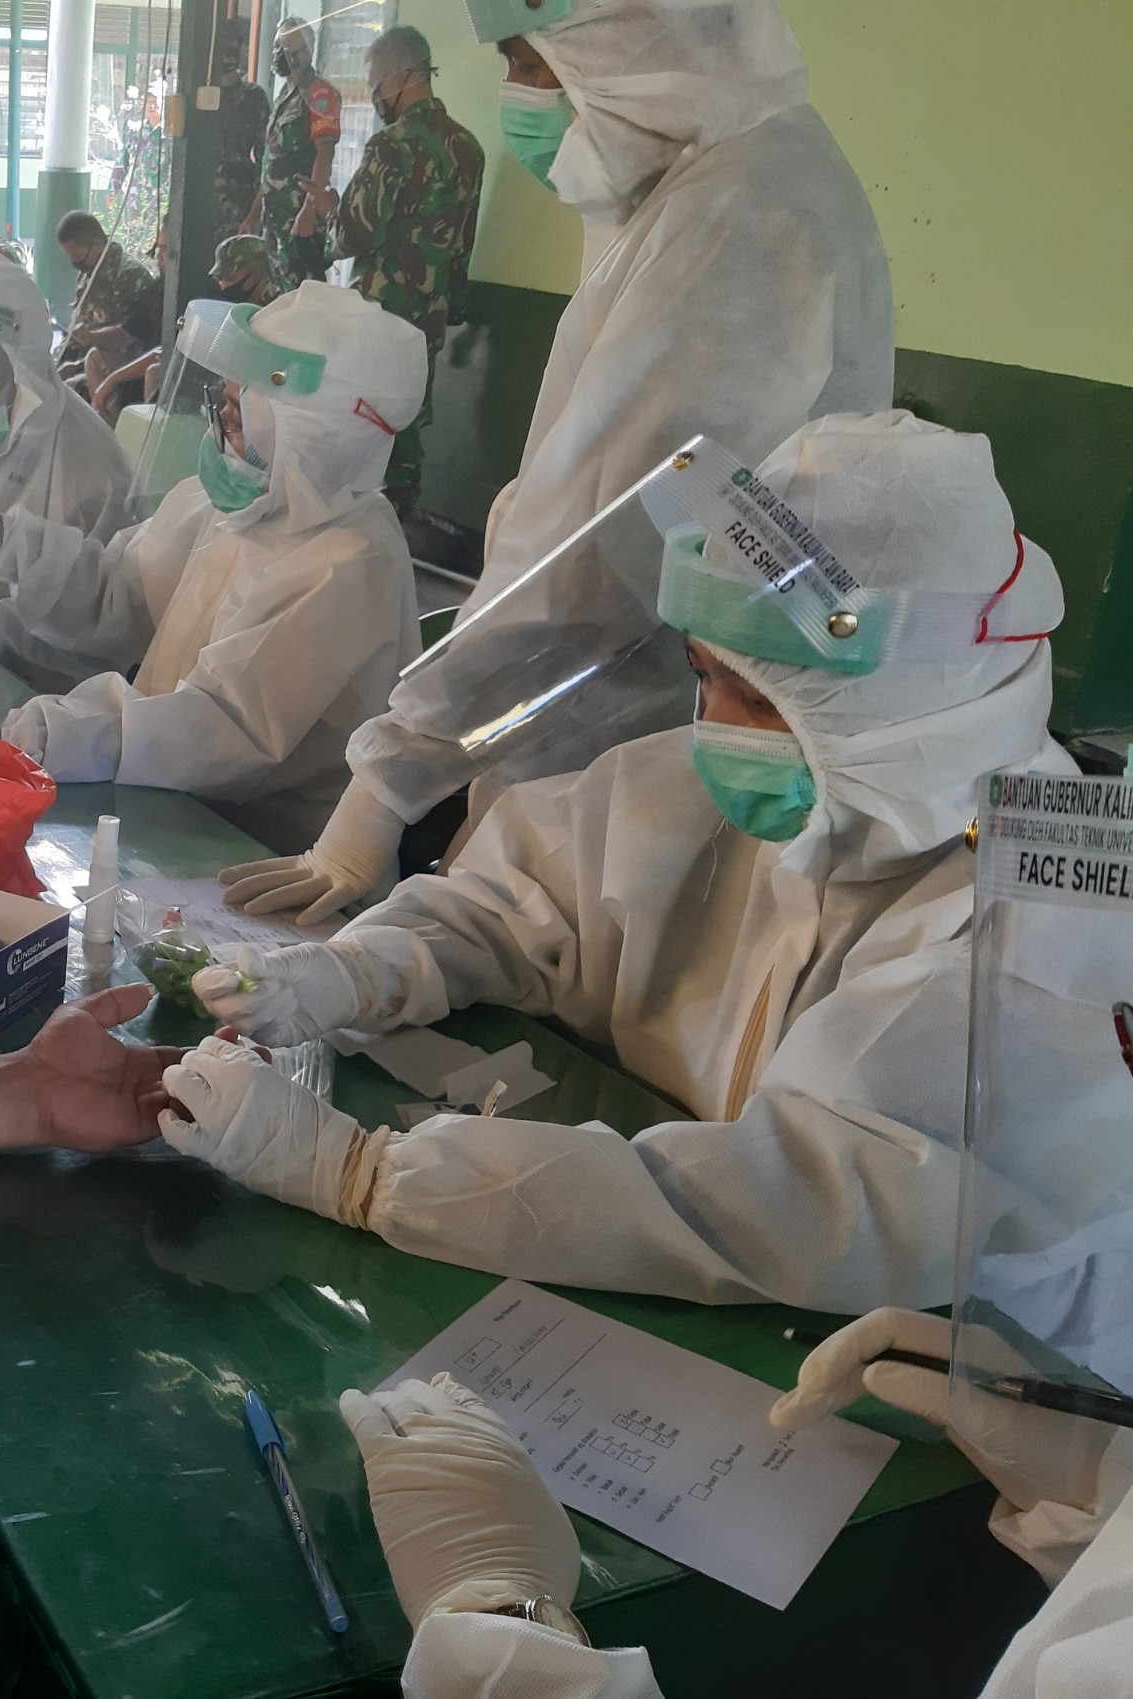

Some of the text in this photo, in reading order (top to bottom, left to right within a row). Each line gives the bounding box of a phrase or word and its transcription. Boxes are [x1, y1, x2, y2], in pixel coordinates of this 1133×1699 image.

[724, 521, 762, 557] FACE
[753, 550, 796, 594] SHIELD
[1002, 776, 1042, 812] BANTUAN
[1043, 780, 1103, 817] GUBERNUR
[1018, 851, 1133, 899] FACE SHIEL
